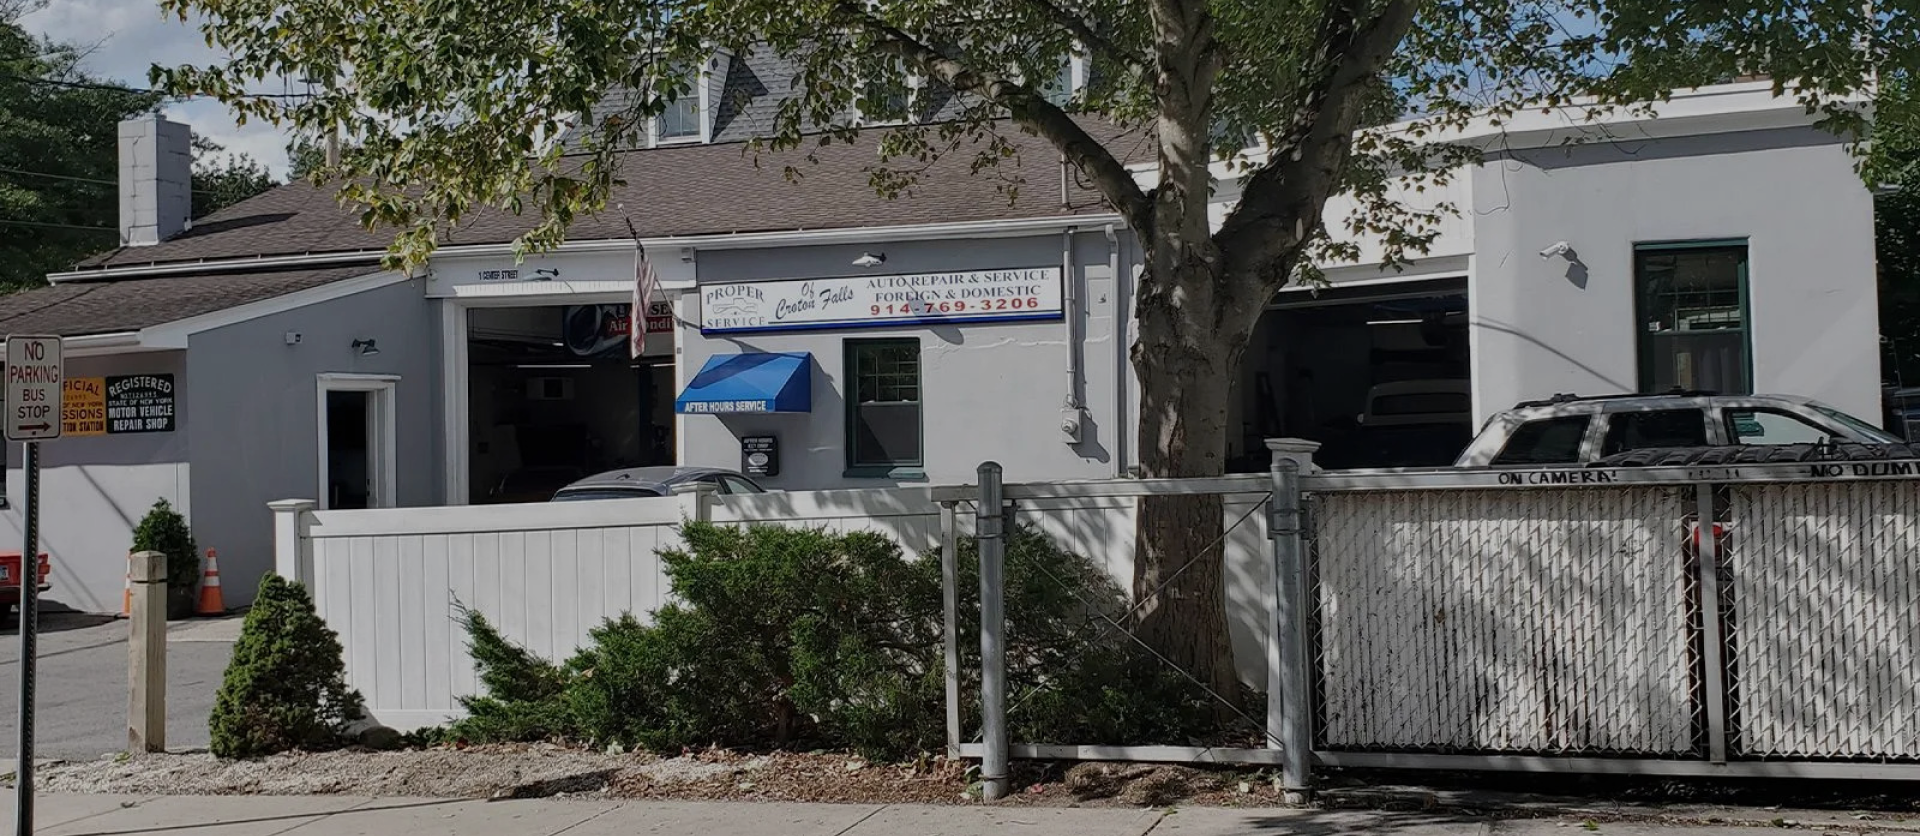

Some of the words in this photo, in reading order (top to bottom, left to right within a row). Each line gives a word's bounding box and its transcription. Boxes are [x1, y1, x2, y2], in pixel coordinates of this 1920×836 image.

[501, 270, 518, 279] STREET
[866, 277, 907, 289] AUTO
[911, 276, 964, 286] REPAIR
[968, 273, 979, 283] &
[984, 270, 1049, 283] SERVICE
[706, 285, 764, 305] PROPER
[801, 282, 815, 298] Of
[875, 289, 940, 302] FOREIGN
[945, 289, 956, 299] &
[961, 285, 1041, 299] DOMESTIC
[651, 304, 672, 316] SE
[775, 298, 815, 320] Croton
[819, 286, 854, 310] Falls
[870, 298, 1038, 315] 914-769-3206
[608, 321, 628, 332] Air
[707, 316, 765, 328] SERVICE
[25, 342, 44, 360] NO
[10, 365, 59, 384] PARKING
[108, 376, 172, 398] REGISTERED
[23, 388, 45, 402] BUS
[18, 405, 50, 419] STOP
[108, 406, 137, 419] MOTOR
[139, 404, 173, 417] VEHICLE
[685, 402, 709, 413] AFTER
[710, 401, 734, 412] HOURS
[736, 400, 766, 411] SERVICE
[79, 421, 104, 432] STATION
[113, 419, 143, 432] REPAIR
[145, 417, 168, 430] SHOP
[1498, 472, 1522, 485] ON
[1528, 470, 1619, 485] CAMERA!
[1810, 464, 1843, 477] NO
